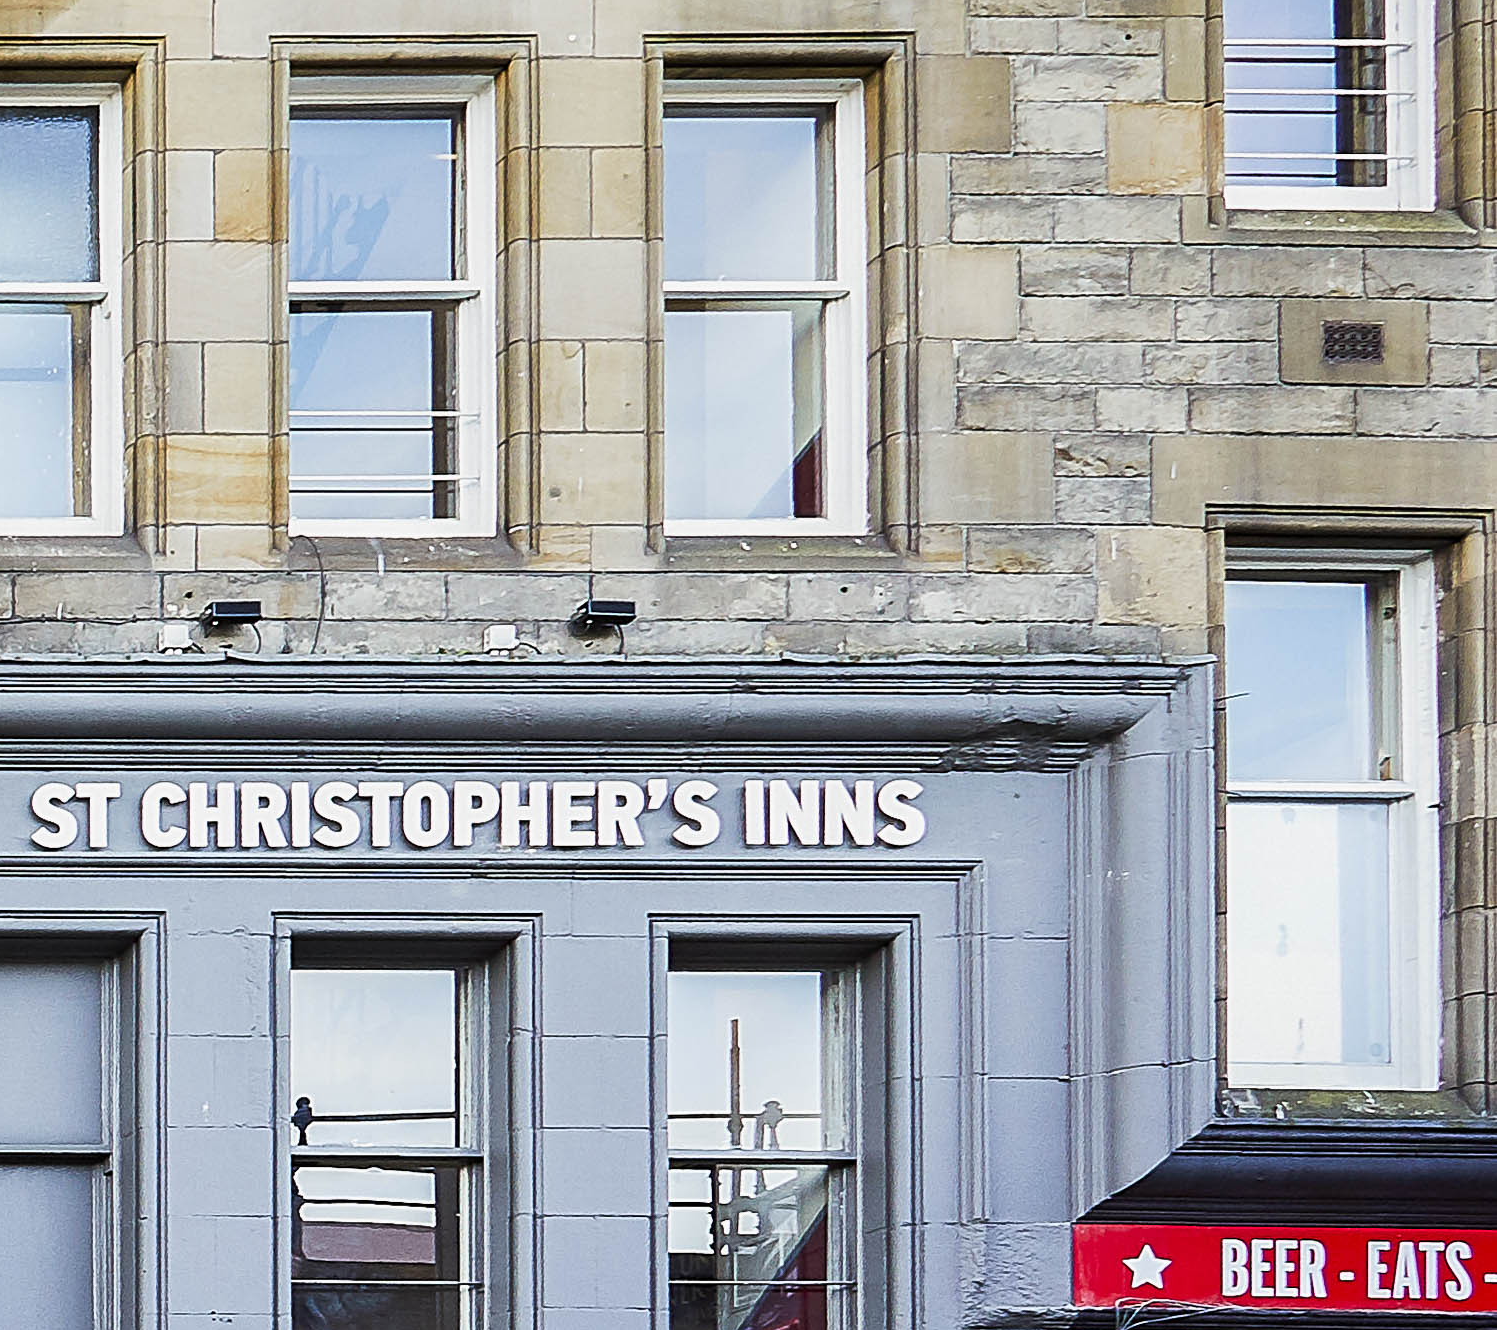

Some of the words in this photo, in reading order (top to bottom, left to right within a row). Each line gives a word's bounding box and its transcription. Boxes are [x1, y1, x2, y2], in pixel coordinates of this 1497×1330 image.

[30, 780, 121, 850] ST
[744, 779, 926, 850] INNS
[1221, 1238, 1327, 1298] BEER
[1366, 1240, 1473, 1301] EATS
